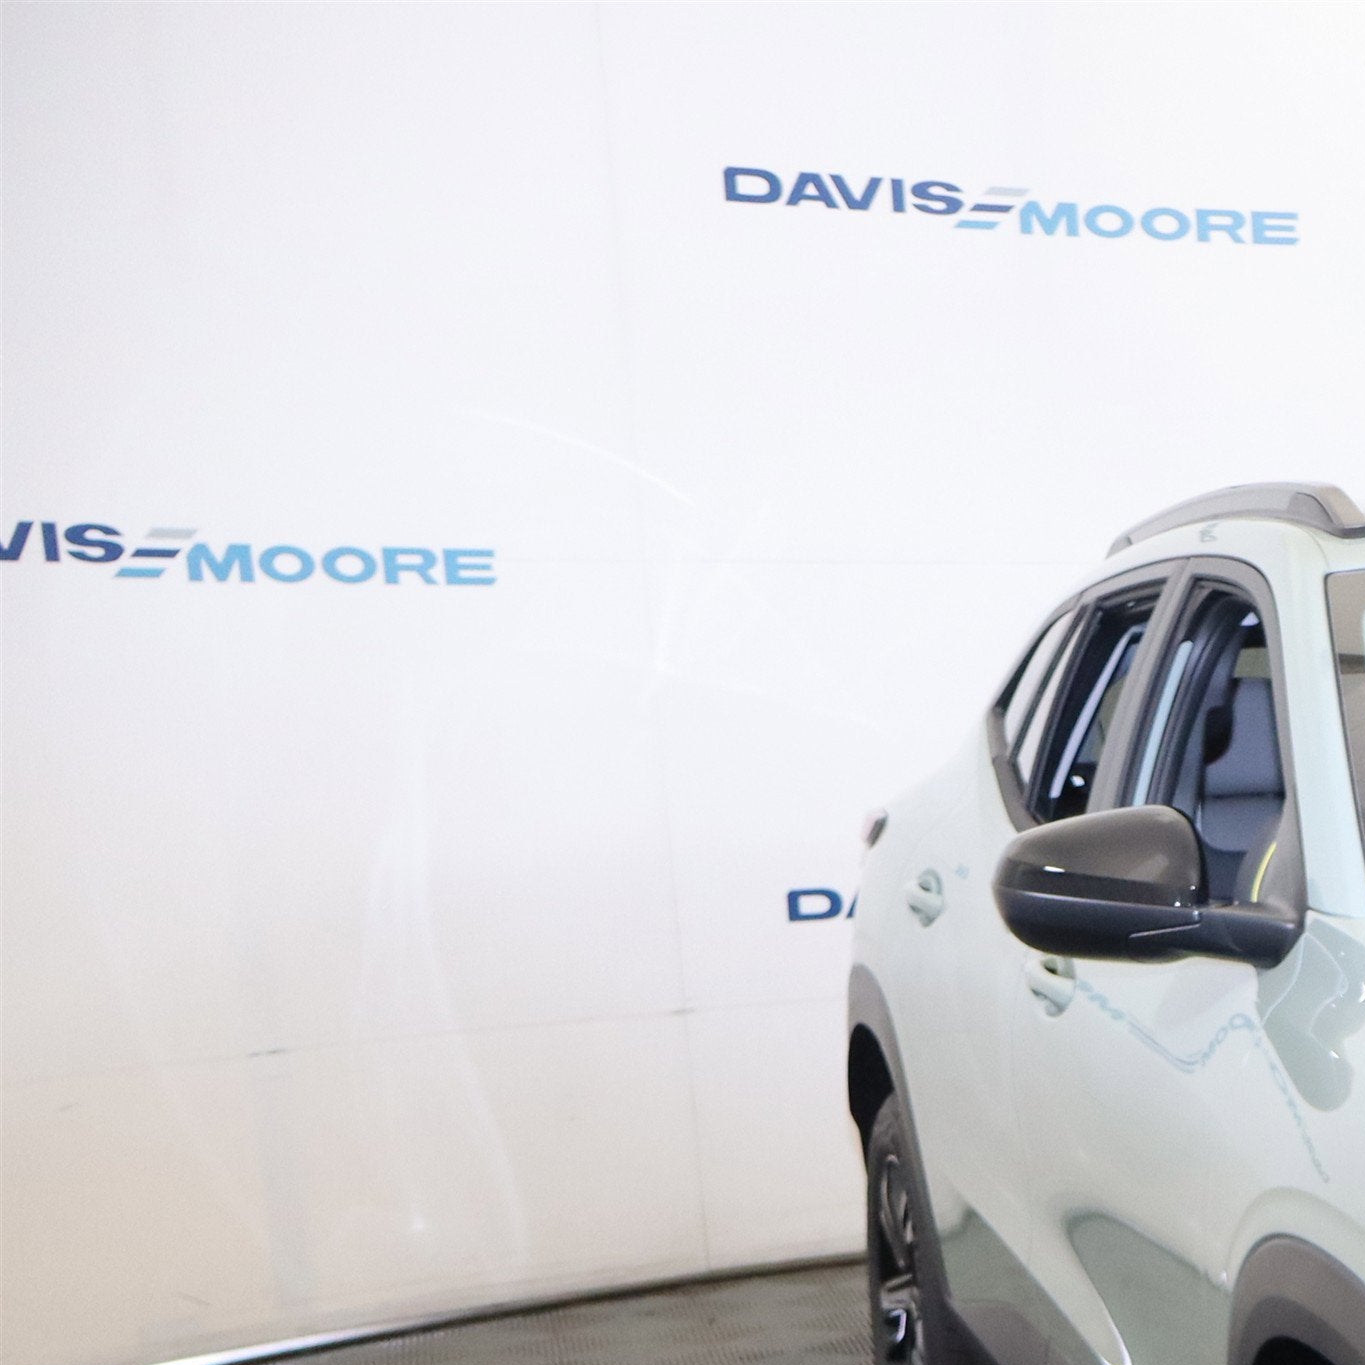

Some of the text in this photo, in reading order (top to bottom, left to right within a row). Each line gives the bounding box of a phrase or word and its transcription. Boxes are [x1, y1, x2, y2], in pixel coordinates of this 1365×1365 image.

[722, 165, 1299, 245] DAVIS MOORE
[0, 519, 497, 586] VIS MOORE
